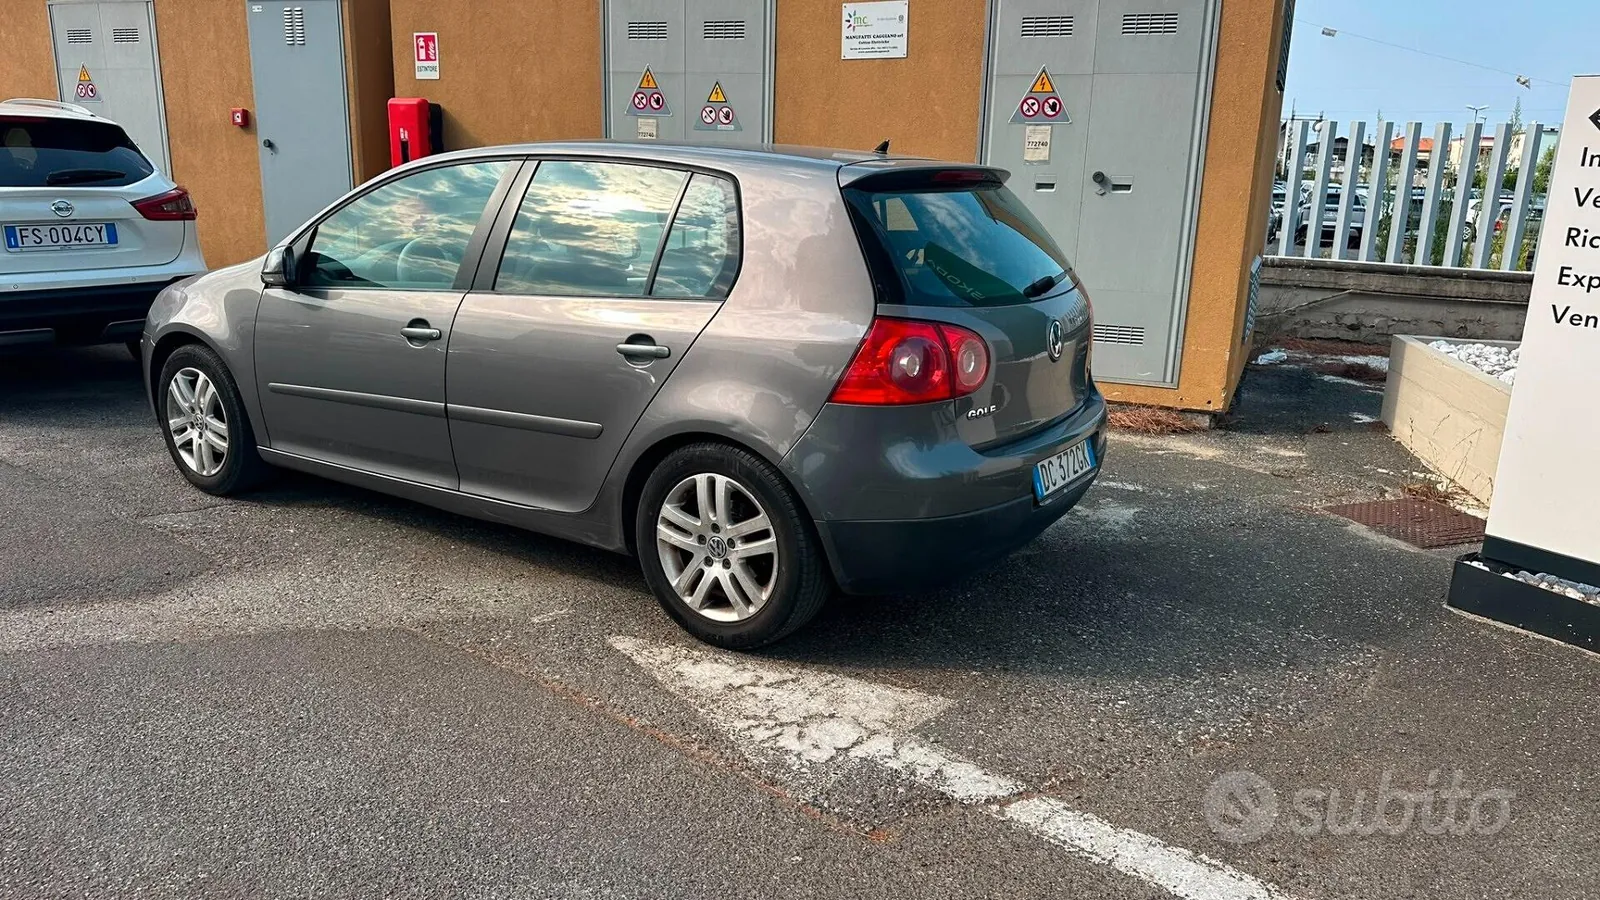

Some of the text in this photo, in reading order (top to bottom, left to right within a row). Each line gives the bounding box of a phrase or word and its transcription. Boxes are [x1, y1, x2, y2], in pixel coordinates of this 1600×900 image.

[1564, 226, 1600, 249] Ric
[1557, 265, 1600, 293] Exp
[1551, 303, 1599, 329] Ven
[967, 404, 996, 420] GOLF
